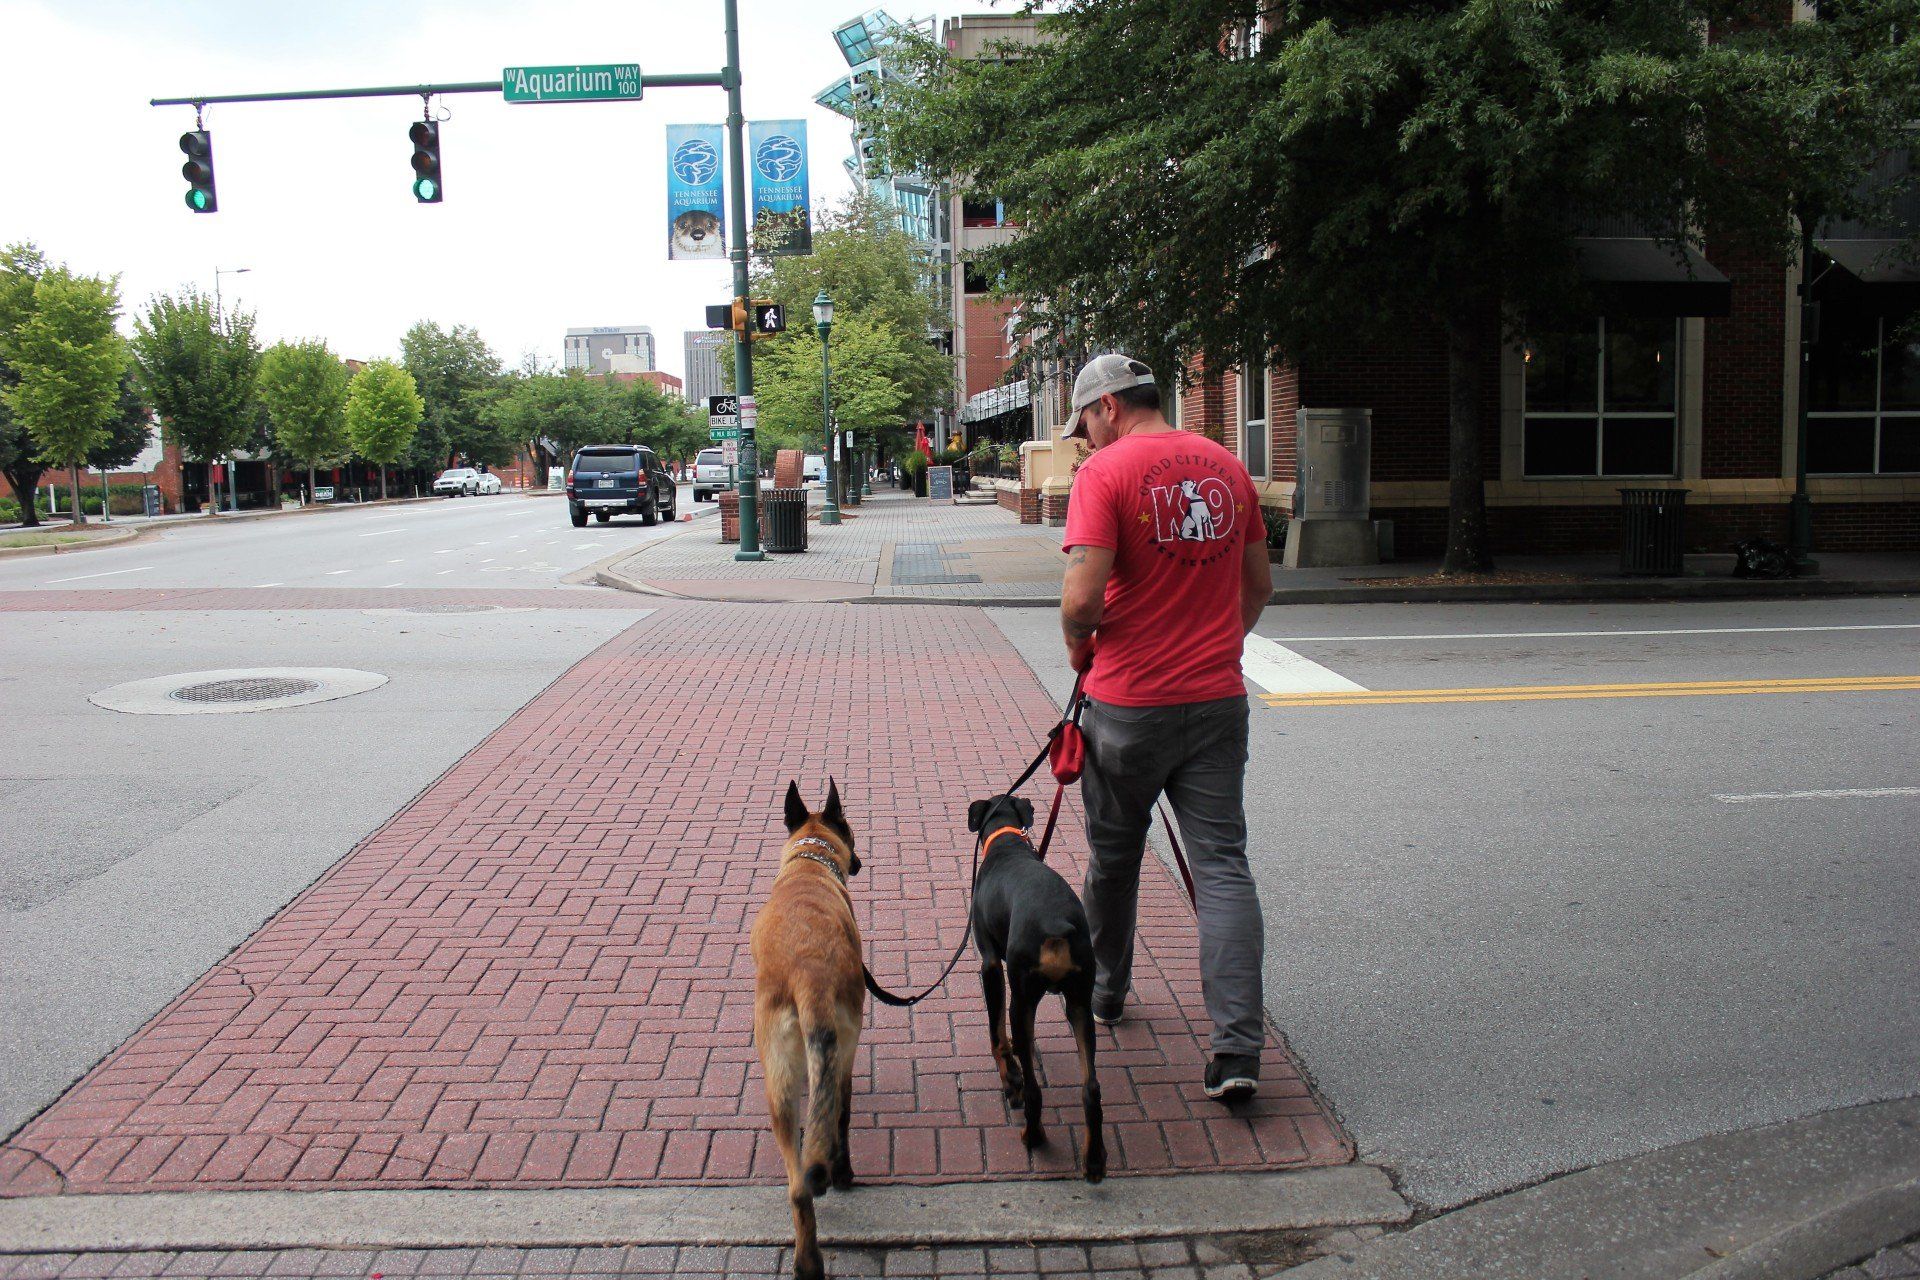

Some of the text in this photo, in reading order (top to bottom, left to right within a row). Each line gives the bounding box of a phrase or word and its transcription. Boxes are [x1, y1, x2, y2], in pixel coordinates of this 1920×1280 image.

[506, 66, 638, 99] W Aquarium WAY
[617, 81, 637, 95] 100
[674, 190, 718, 198] TENNESSEE
[758, 186, 803, 194] TENNESSEE
[673, 198, 718, 207] AQUARIUM
[758, 194, 803, 203] AQUARIUM
[711, 416, 738, 425] BIKE LA
[1139, 454, 1236, 496] GOOD CITIZEN
[1151, 477, 1235, 543] K9
